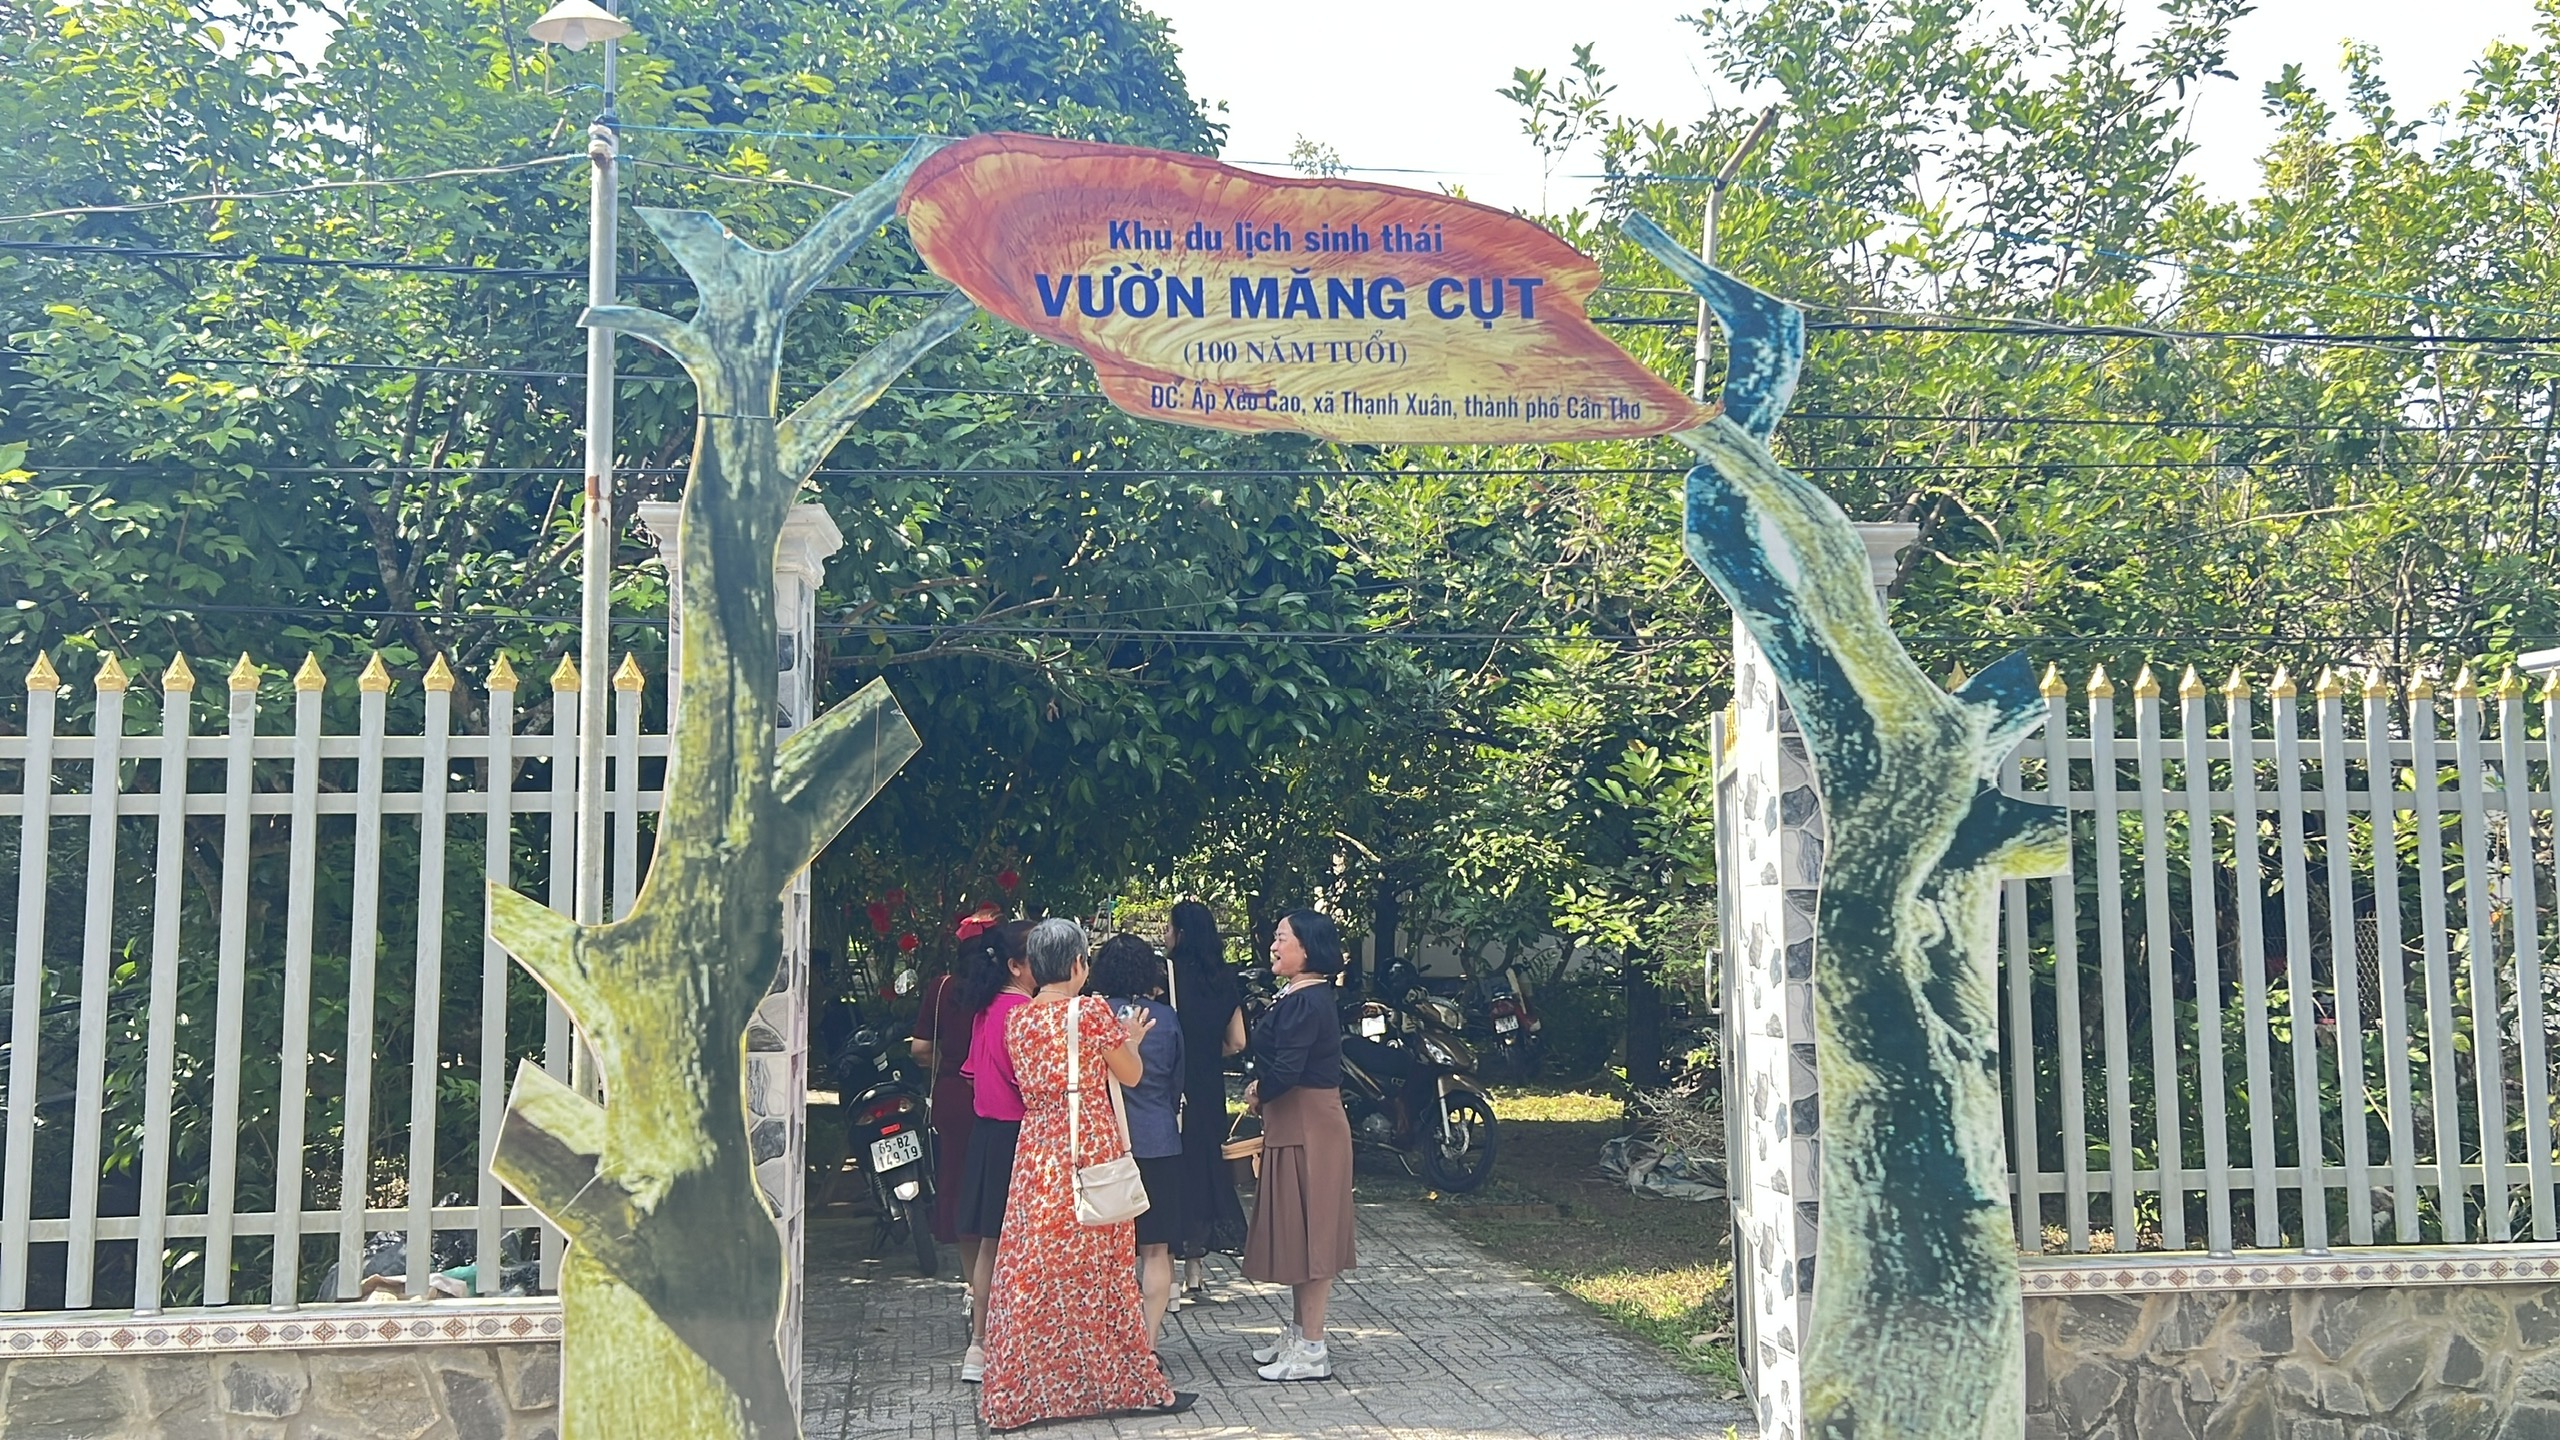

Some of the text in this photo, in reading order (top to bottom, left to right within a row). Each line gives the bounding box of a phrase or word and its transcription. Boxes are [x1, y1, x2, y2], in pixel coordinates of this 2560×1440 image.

[1108, 220, 1443, 259] Khu du lịch sinh thái
[1034, 262, 1544, 329] VƯỜN MĂNG CỤT
[1184, 329, 1407, 368] (100 NĂM TUỔI)
[1151, 385, 1184, 409] ĐC:
[1265, 389, 1306, 416] Cao,
[1313, 391, 1335, 413] xã
[1341, 391, 1398, 419] Thạnh
[1405, 393, 1458, 420] Xuân,
[1465, 394, 1519, 418] thành
[1526, 395, 1561, 423] phố
[1567, 396, 1601, 419] Cần
[1608, 397, 1641, 421] Thơ
[878, 1135, 911, 1155] 65-B2
